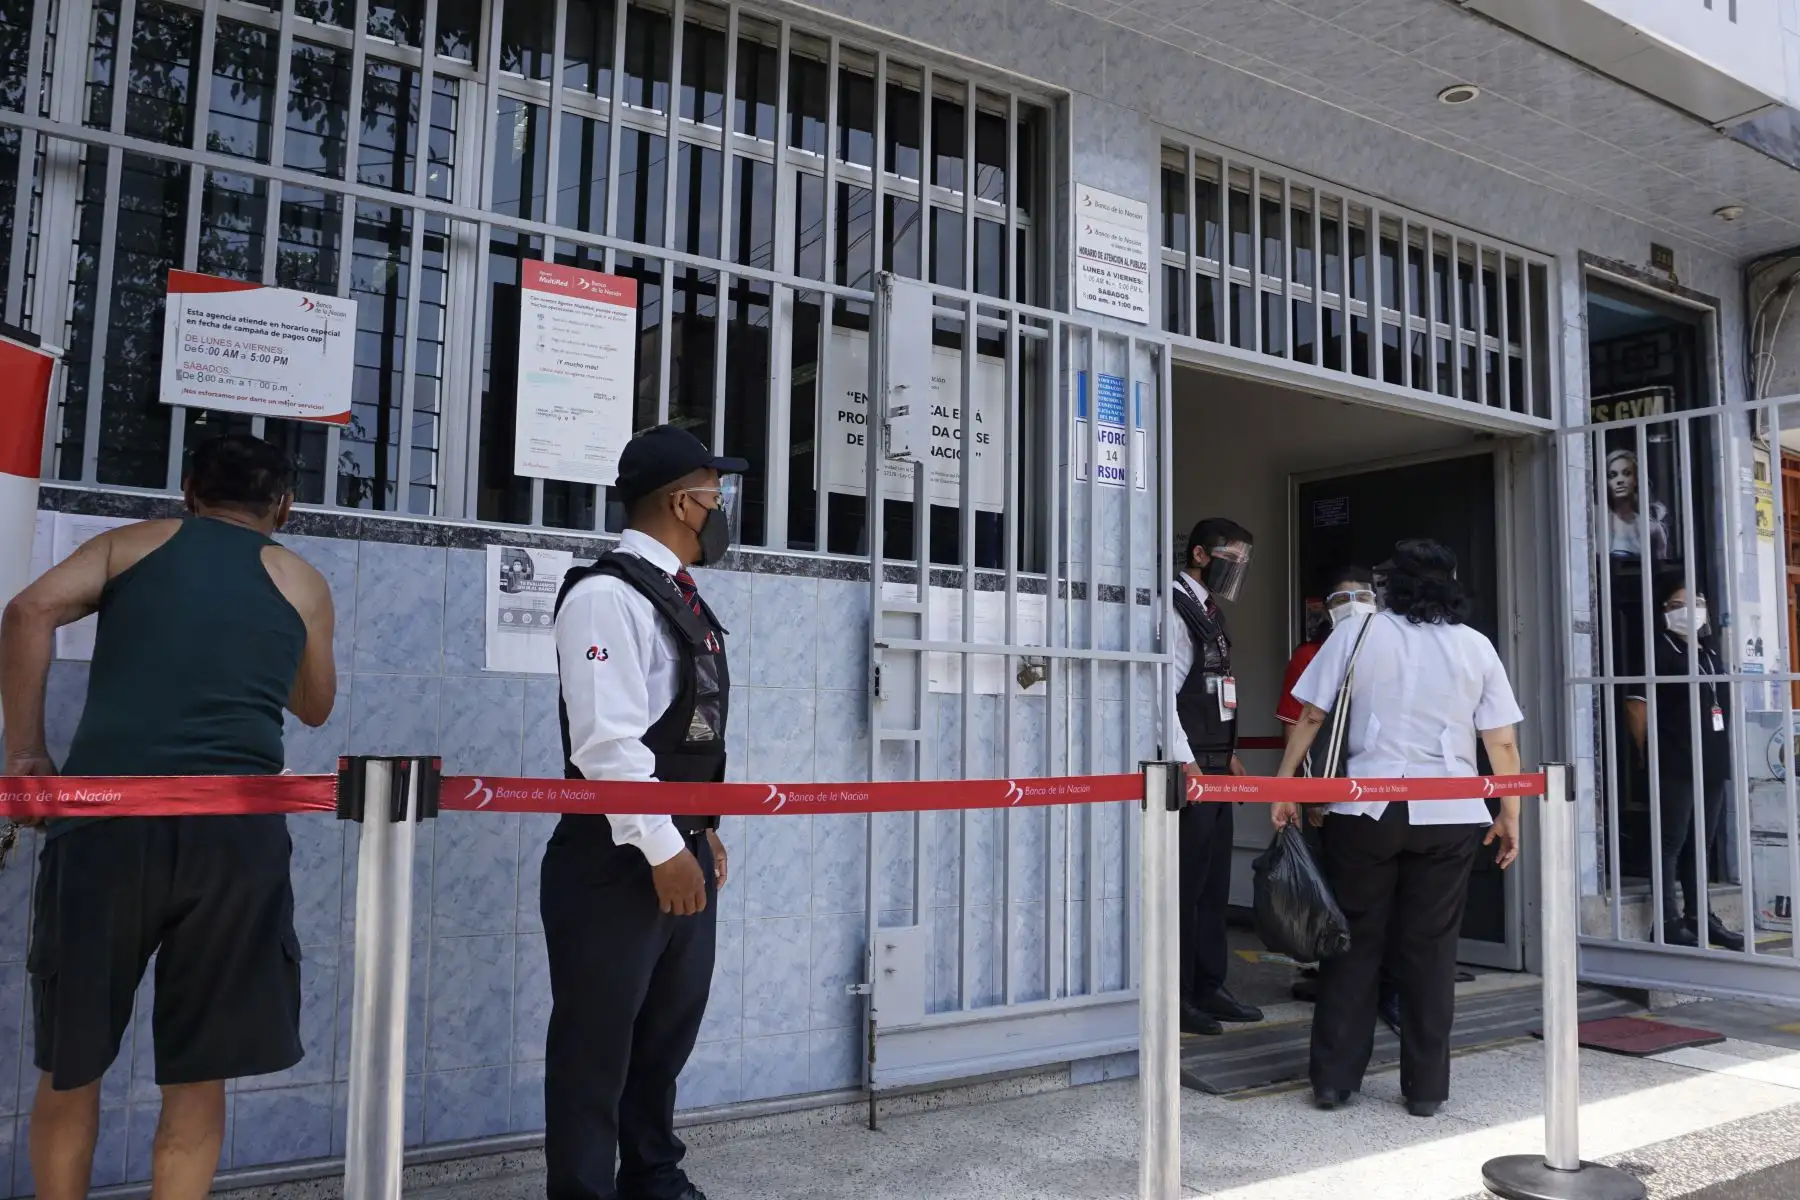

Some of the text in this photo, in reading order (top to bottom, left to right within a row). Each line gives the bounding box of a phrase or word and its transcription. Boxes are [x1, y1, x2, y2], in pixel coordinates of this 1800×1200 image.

[1094, 200, 1110, 210] Banco
[1083, 265, 1104, 275] LUNES
[187, 308, 204, 316] Esta
[206, 312, 236, 322] agencia
[238, 317, 267, 326] atiende
[281, 322, 309, 332] horario
[310, 327, 340, 337] especial
[199, 318, 220, 329] fecha
[234, 326, 269, 335] campaña
[282, 333, 304, 341] pagos
[307, 335, 322, 343] ONP
[185, 333, 198, 342] DE
[201, 335, 232, 348] LUNES
[184, 344, 196, 352] De
[222, 349, 239, 359] AM
[273, 355, 289, 365] PM
[564, 360, 583, 368] mucho
[183, 371, 194, 379] De
[1615, 395, 1664, 420] GYM
[847, 433, 864, 446] DE
[1106, 450, 1118, 461] 14
[496, 787, 595, 800] Banco de la Nación
[1025, 785, 1046, 796] Banco
[1048, 785, 1056, 794] de
[1059, 785, 1064, 794] la
[1204, 783, 1221, 792] Banco
[1223, 784, 1230, 792] de
[0, 789, 122, 802] anco de la Nación
[788, 791, 814, 802] Banco
[817, 791, 828, 801] de
[829, 791, 837, 801] la
